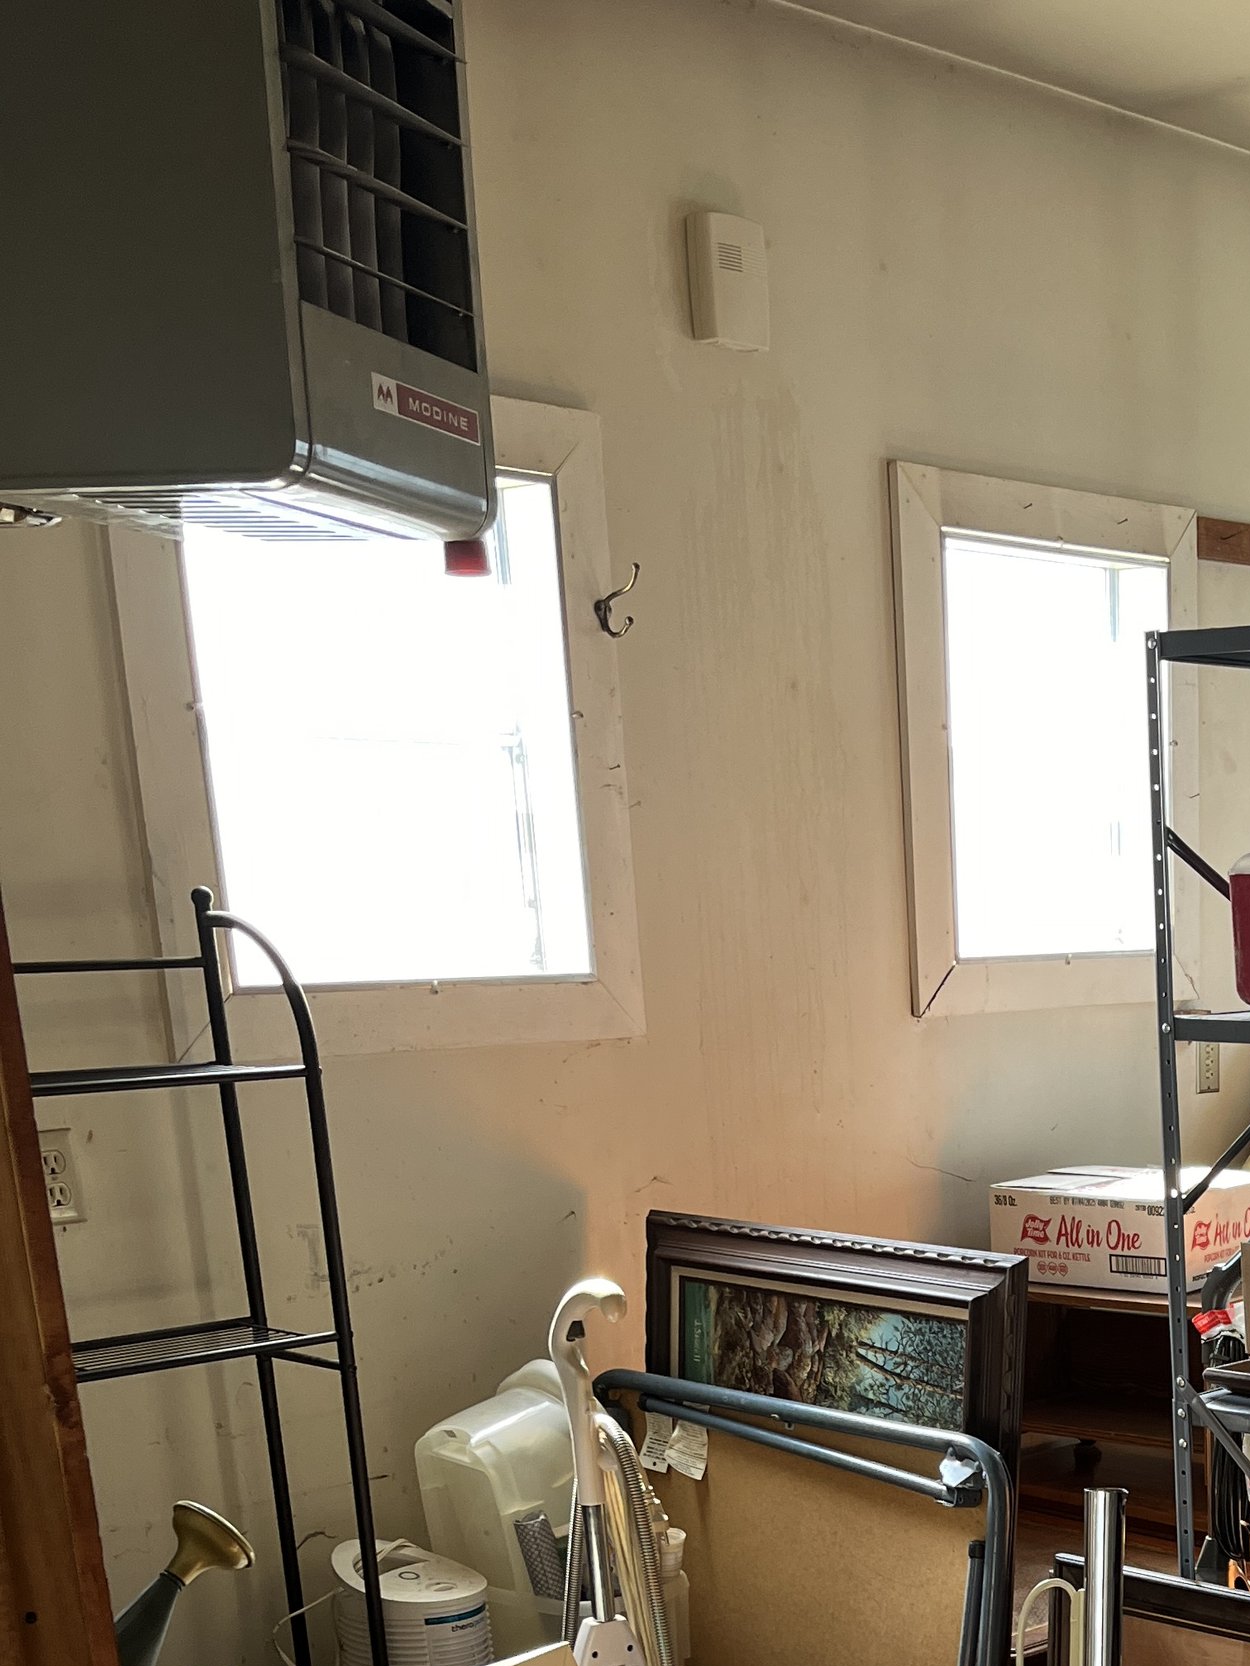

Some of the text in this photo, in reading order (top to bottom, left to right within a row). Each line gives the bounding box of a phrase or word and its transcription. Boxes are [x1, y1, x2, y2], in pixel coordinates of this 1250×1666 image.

[409, 397, 469, 431] MODINE
[1025, 1219, 1045, 1231] Jolly
[1055, 1214, 1143, 1252] All in One
[1027, 1228, 1045, 1239] Time
[1013, 1247, 1038, 1258] POPCORN
[1047, 1250, 1058, 1260] FOR
[1072, 1253, 1091, 1263] KETTLE
